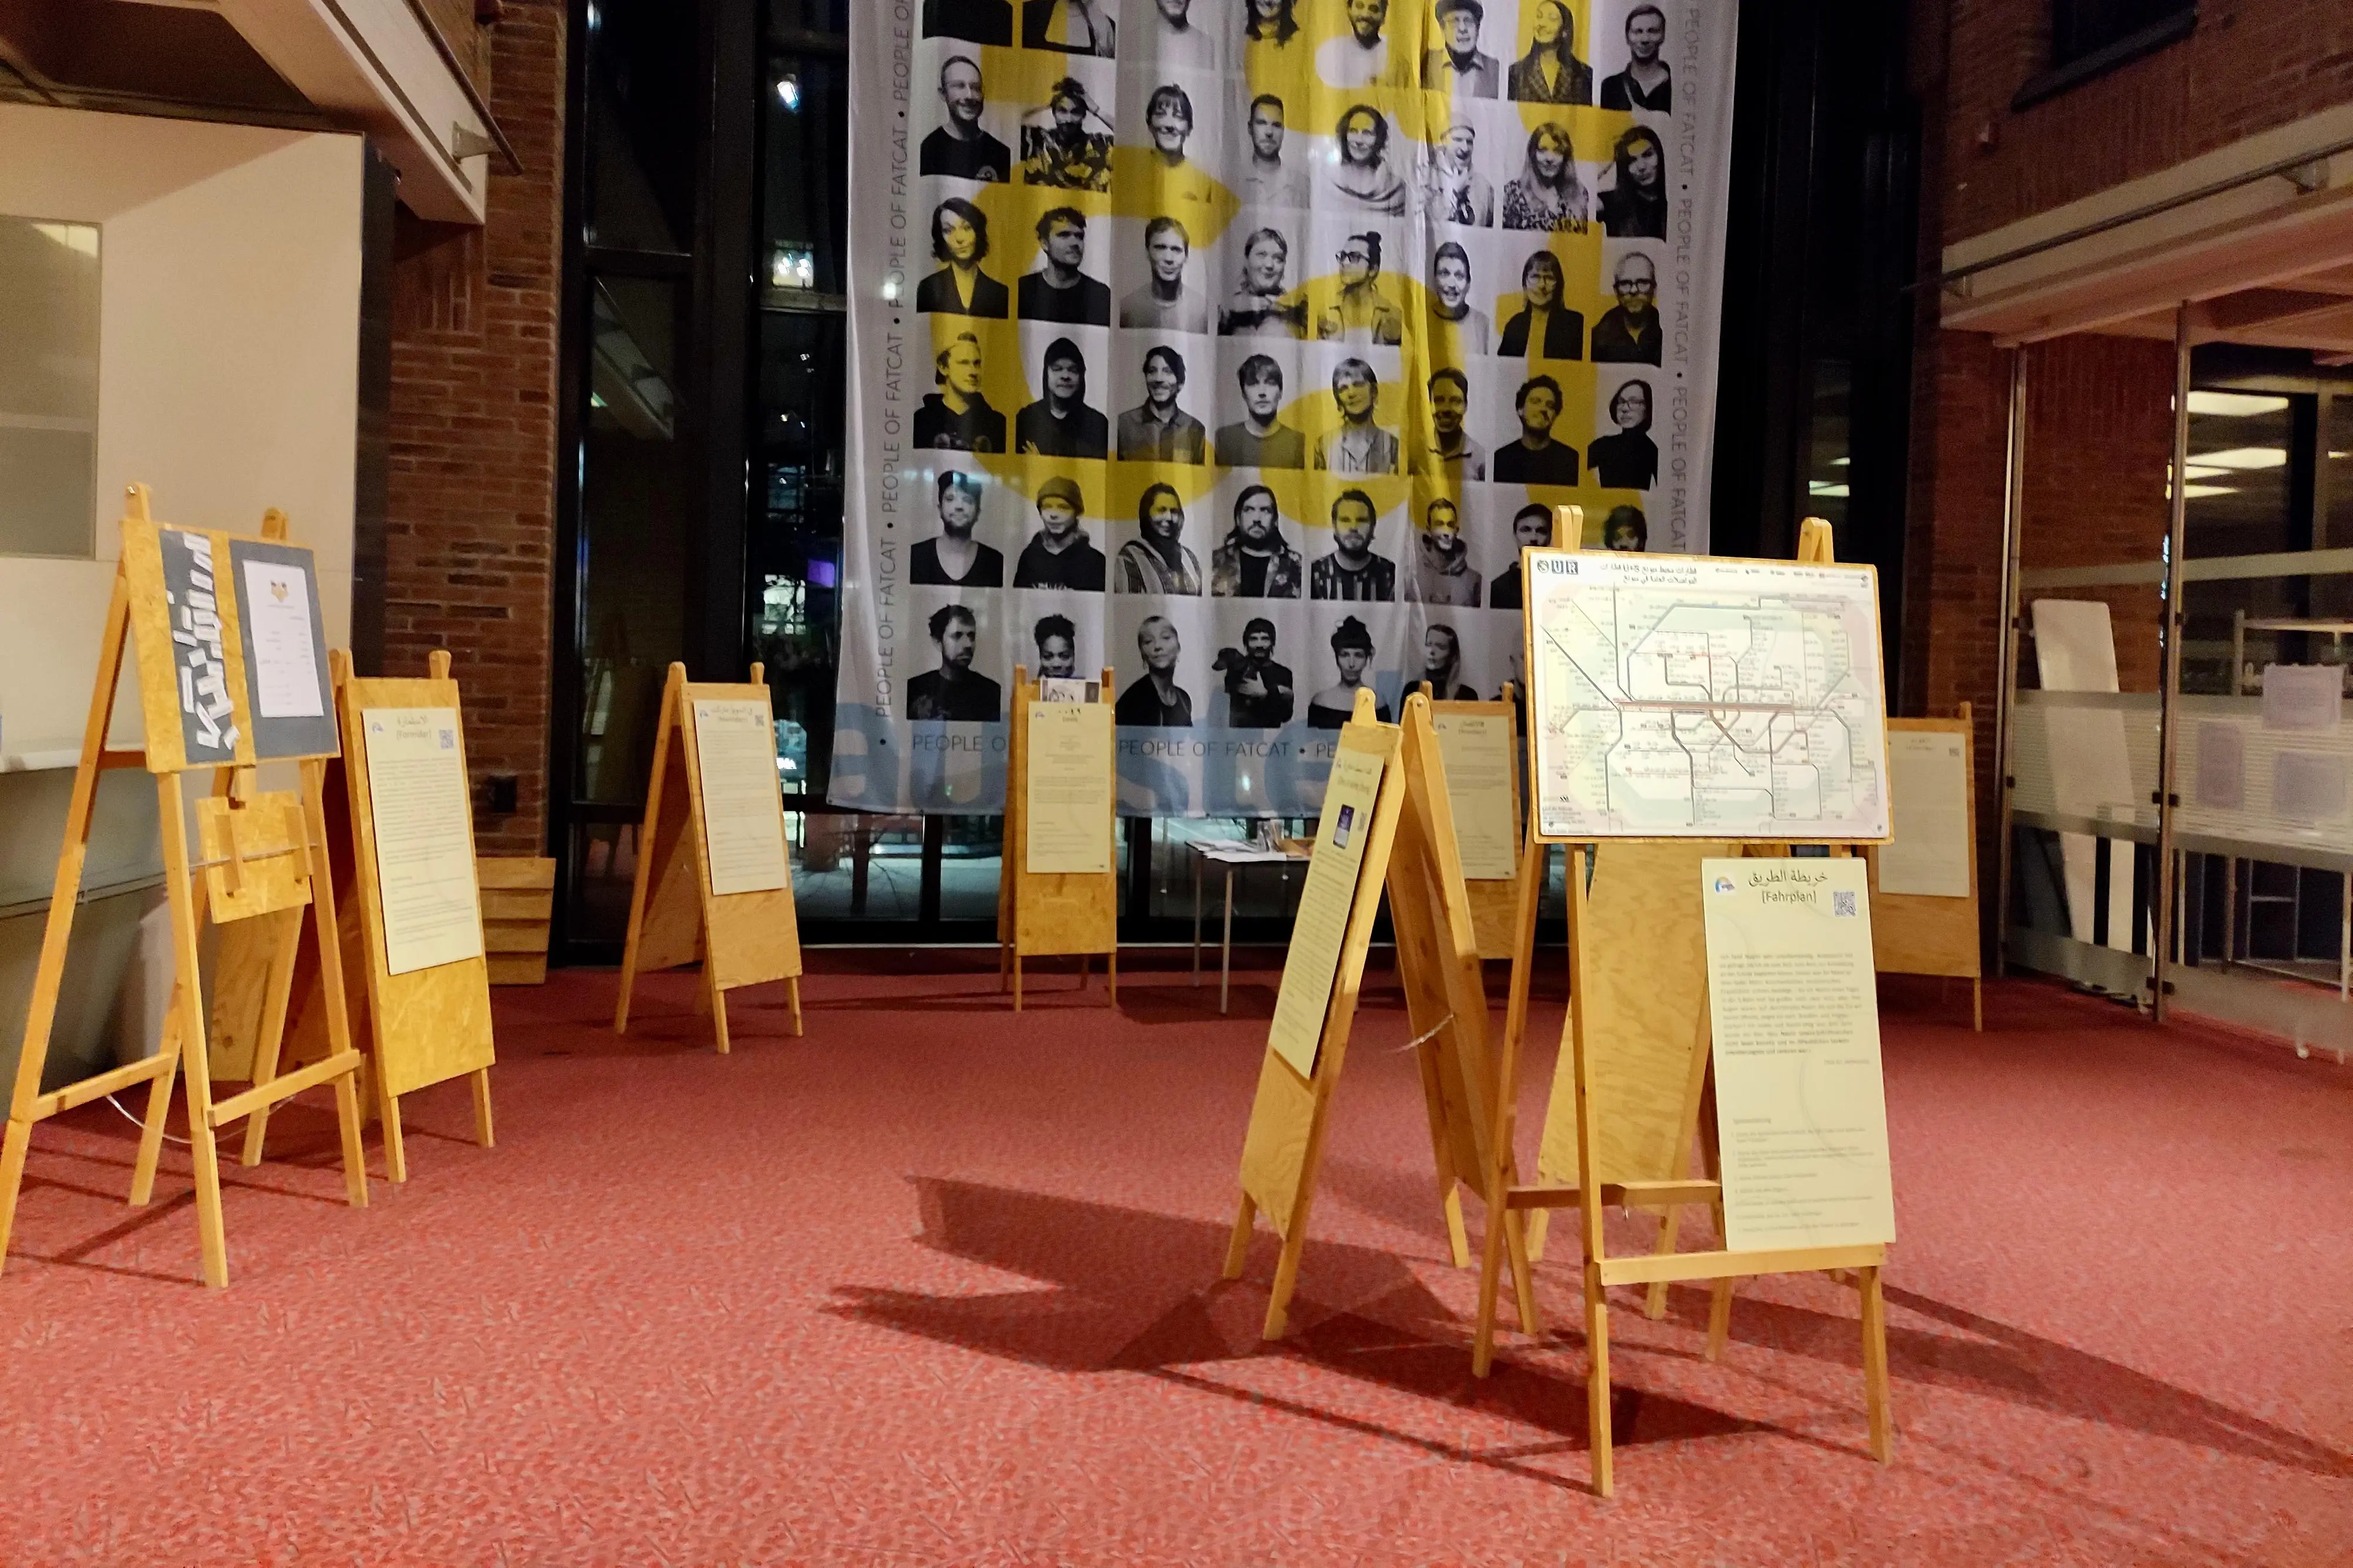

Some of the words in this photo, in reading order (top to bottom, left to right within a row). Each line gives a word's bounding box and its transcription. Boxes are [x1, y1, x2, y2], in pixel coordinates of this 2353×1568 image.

[893, 27, 909, 102] PEOPLE
[1682, 8, 1701, 76] PEOPLE
[1682, 81, 1697, 108] OF
[891, 125, 908, 196] FATCAT
[1679, 112, 1696, 176] FATCAT
[890, 201, 906, 229] OF
[1676, 198, 1693, 265] PEOPLE
[1676, 269, 1690, 295] OF
[1674, 301, 1689, 367] FATCAT
[886, 332, 903, 401] FATCAT
[884, 408, 901, 435] OF
[1671, 387, 1688, 452] PEOPLE
[882, 441, 900, 513] PEOPLE
[1671, 458, 1687, 482] OF
[1670, 488, 1687, 552] FATCAT
[879, 537, 896, 606] FATCAT
[878, 612, 895, 639] OF
[875, 646, 894, 718] PEOPLE
[912, 733, 982, 752] PEOPLE
[1119, 739, 1185, 757] PEOPLE
[1193, 741, 1218, 757] OF
[1225, 742, 1288, 758] FATCAT
[1748, 868, 1787, 887] الطريق
[1790, 868, 1829, 887] خريطة
